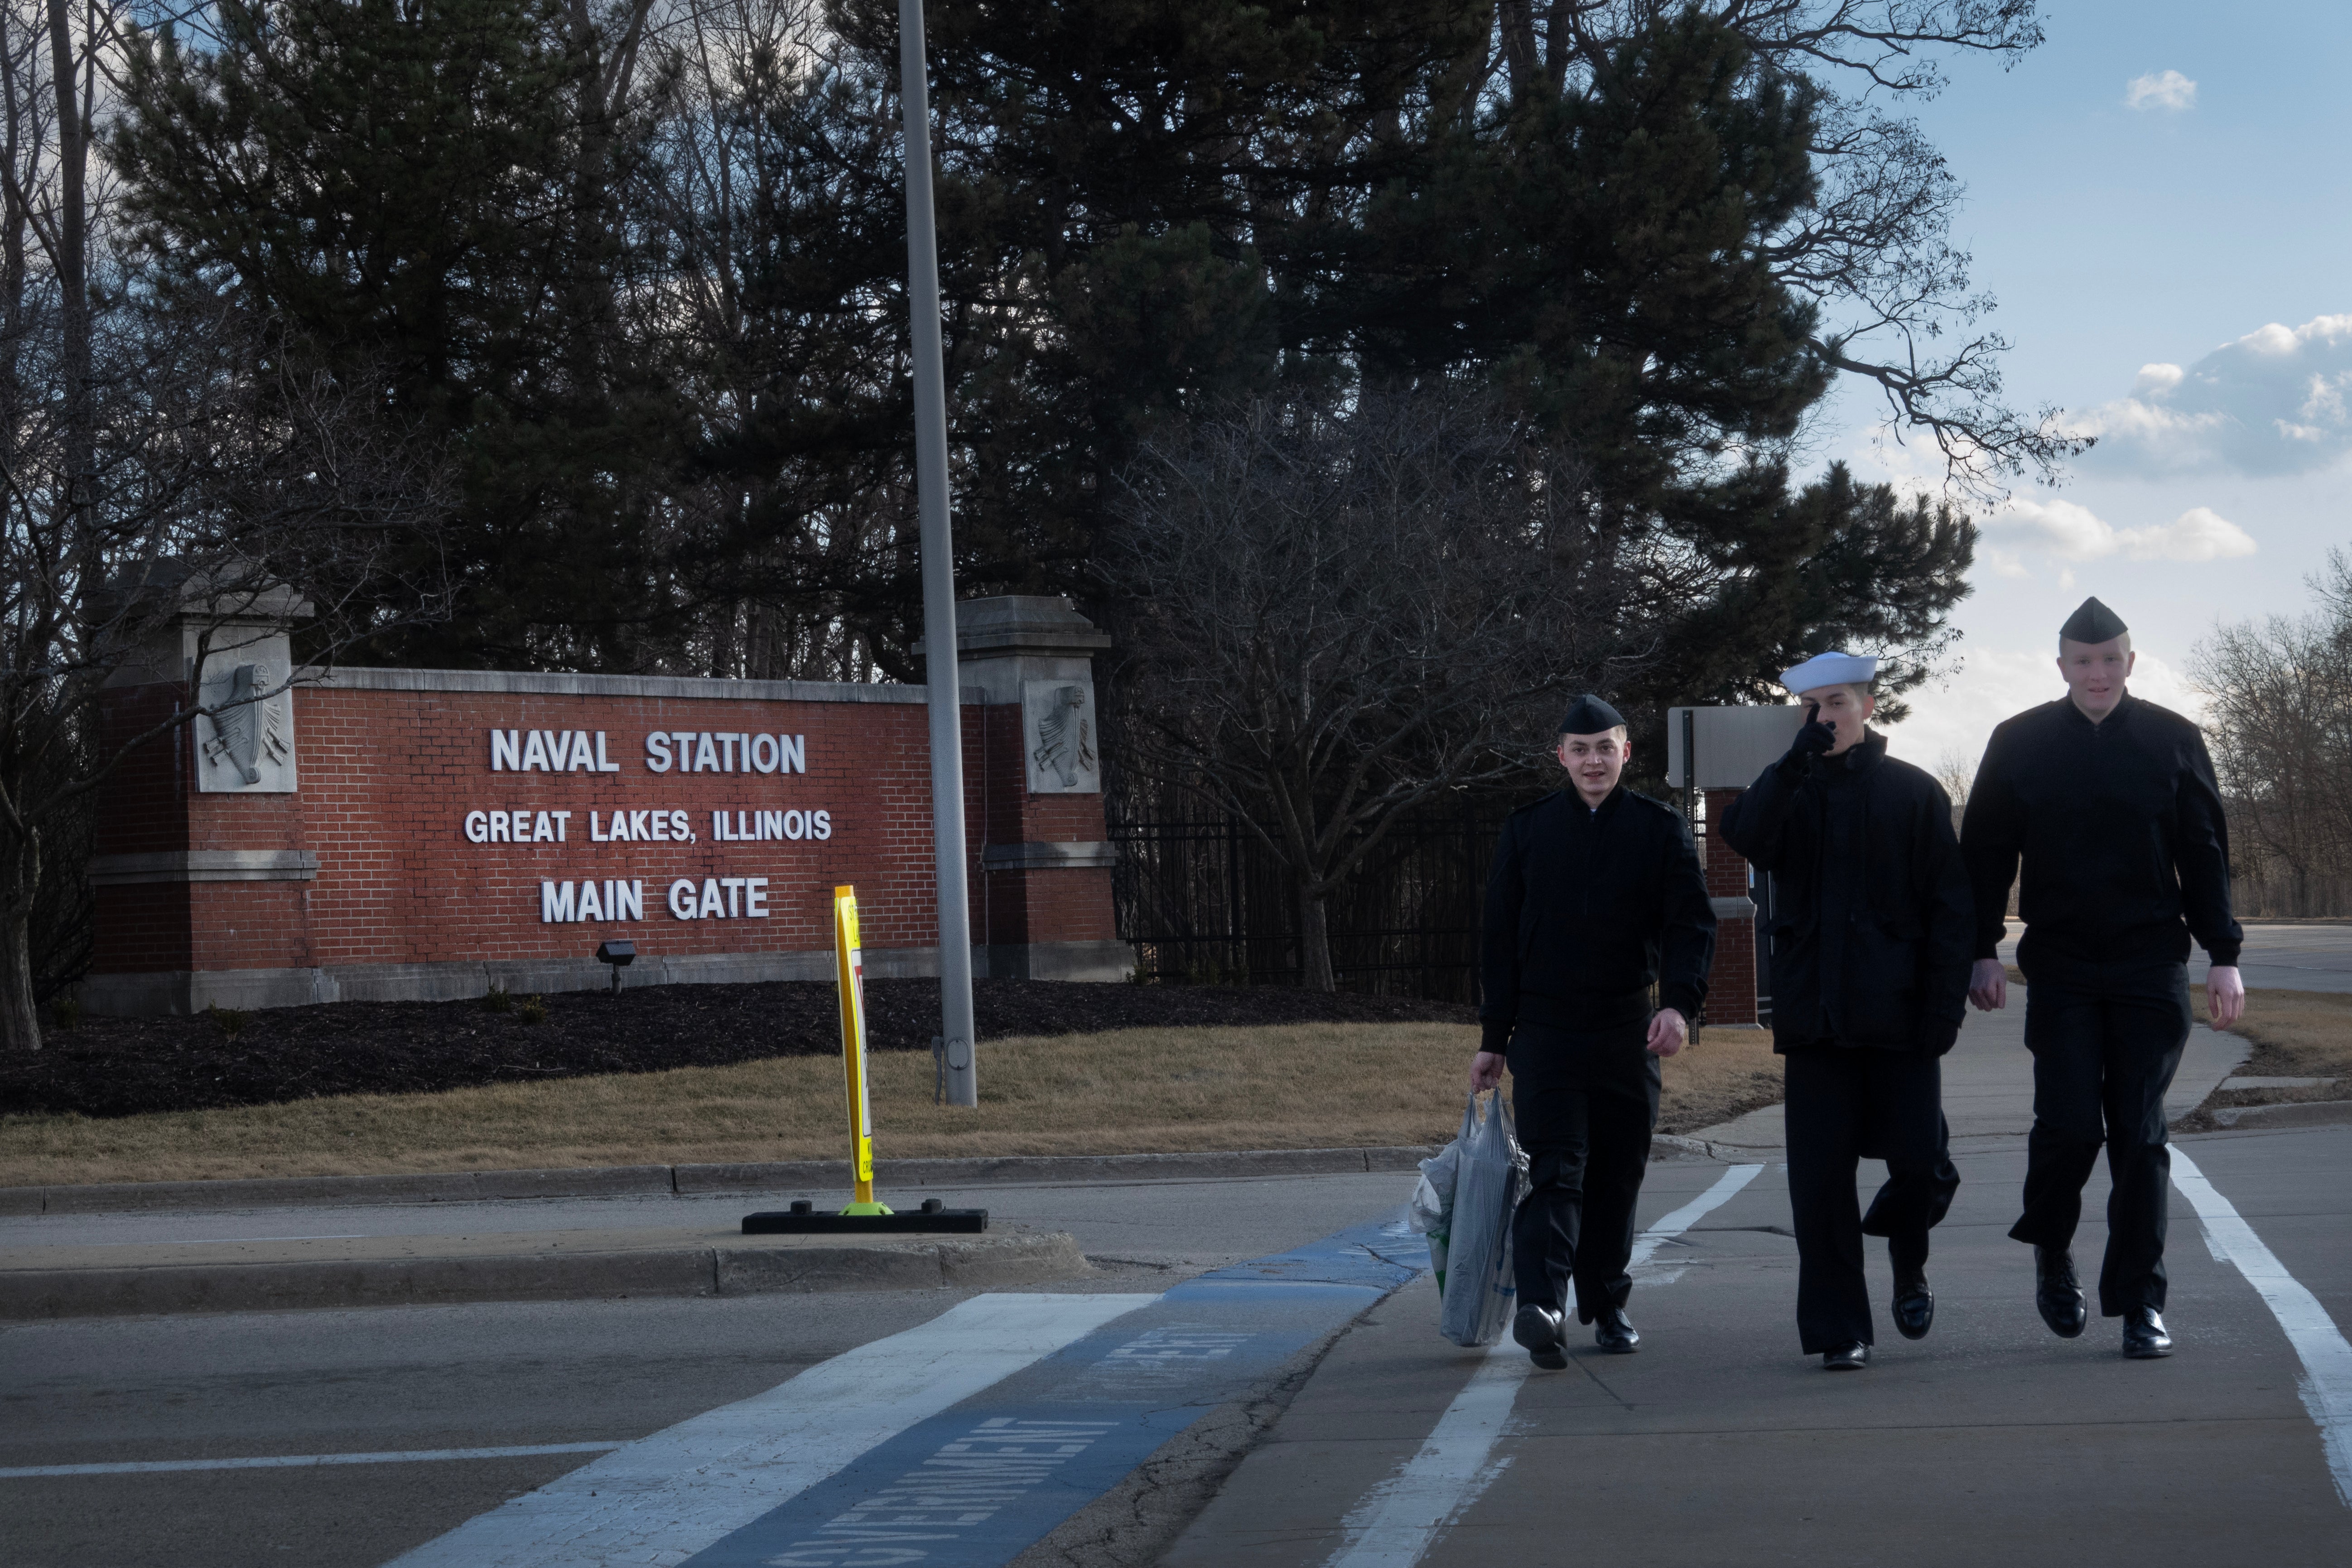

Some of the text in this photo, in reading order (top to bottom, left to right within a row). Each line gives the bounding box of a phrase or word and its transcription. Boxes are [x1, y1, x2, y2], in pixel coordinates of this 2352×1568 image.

[491, 729, 805, 773] NAVAL STATION
[465, 810, 831, 844] GREAT LAKES, ILLINOIS
[541, 877, 769, 922] MAIN GATE
[761, 1417, 1121, 1568] OVERNMENT
